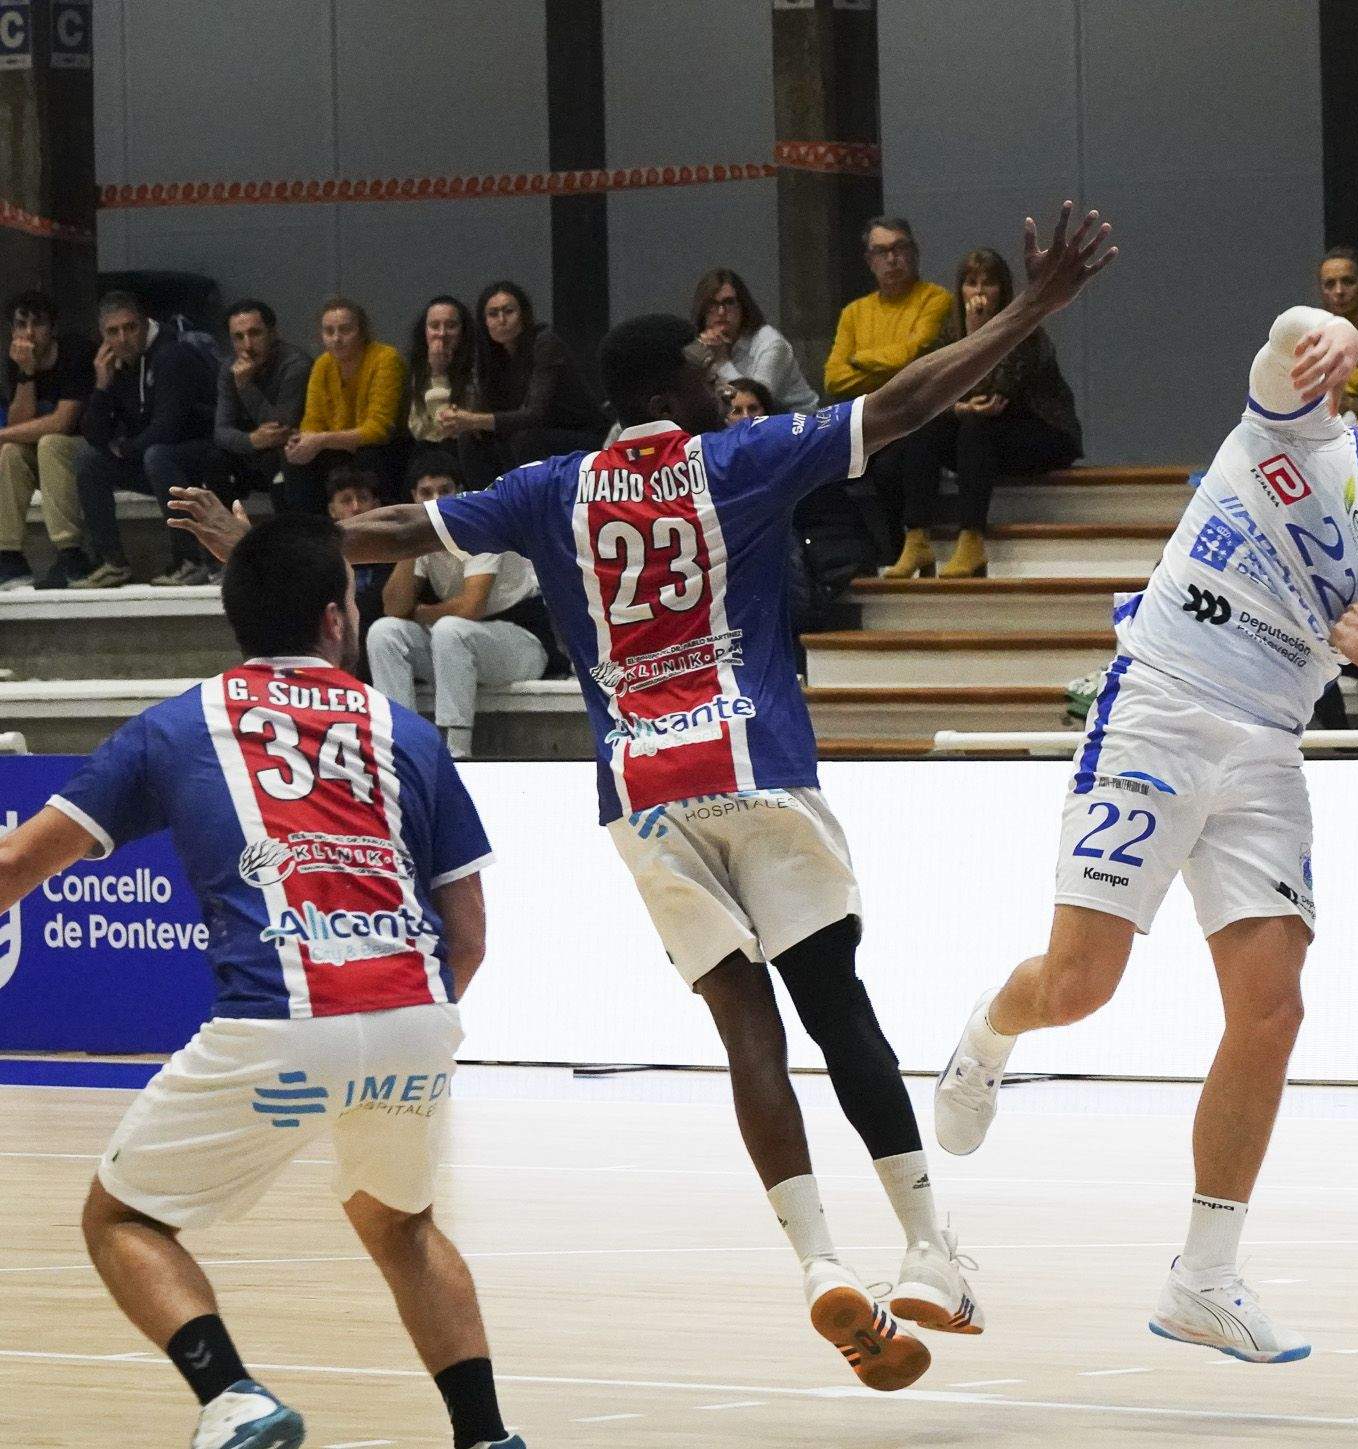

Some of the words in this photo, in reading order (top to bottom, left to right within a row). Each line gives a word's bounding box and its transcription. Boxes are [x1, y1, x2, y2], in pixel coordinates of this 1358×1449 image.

[0, 10, 24, 48] C
[577, 469, 643, 503] MAHO
[597, 517, 703, 625] 23
[1285, 516, 1357, 621] 22
[1239, 611, 1311, 656] Deputación
[227, 678, 259, 701] G.
[268, 681, 368, 713] SULER
[607, 696, 755, 747] Alicante
[239, 706, 375, 804] 34
[685, 797, 800, 823] HOSPITALES
[1072, 802, 1156, 867] 22
[42, 868, 172, 903] Concello
[1083, 867, 1129, 886] Kempa
[44, 913, 82, 948] de
[265, 902, 434, 946] Alicante
